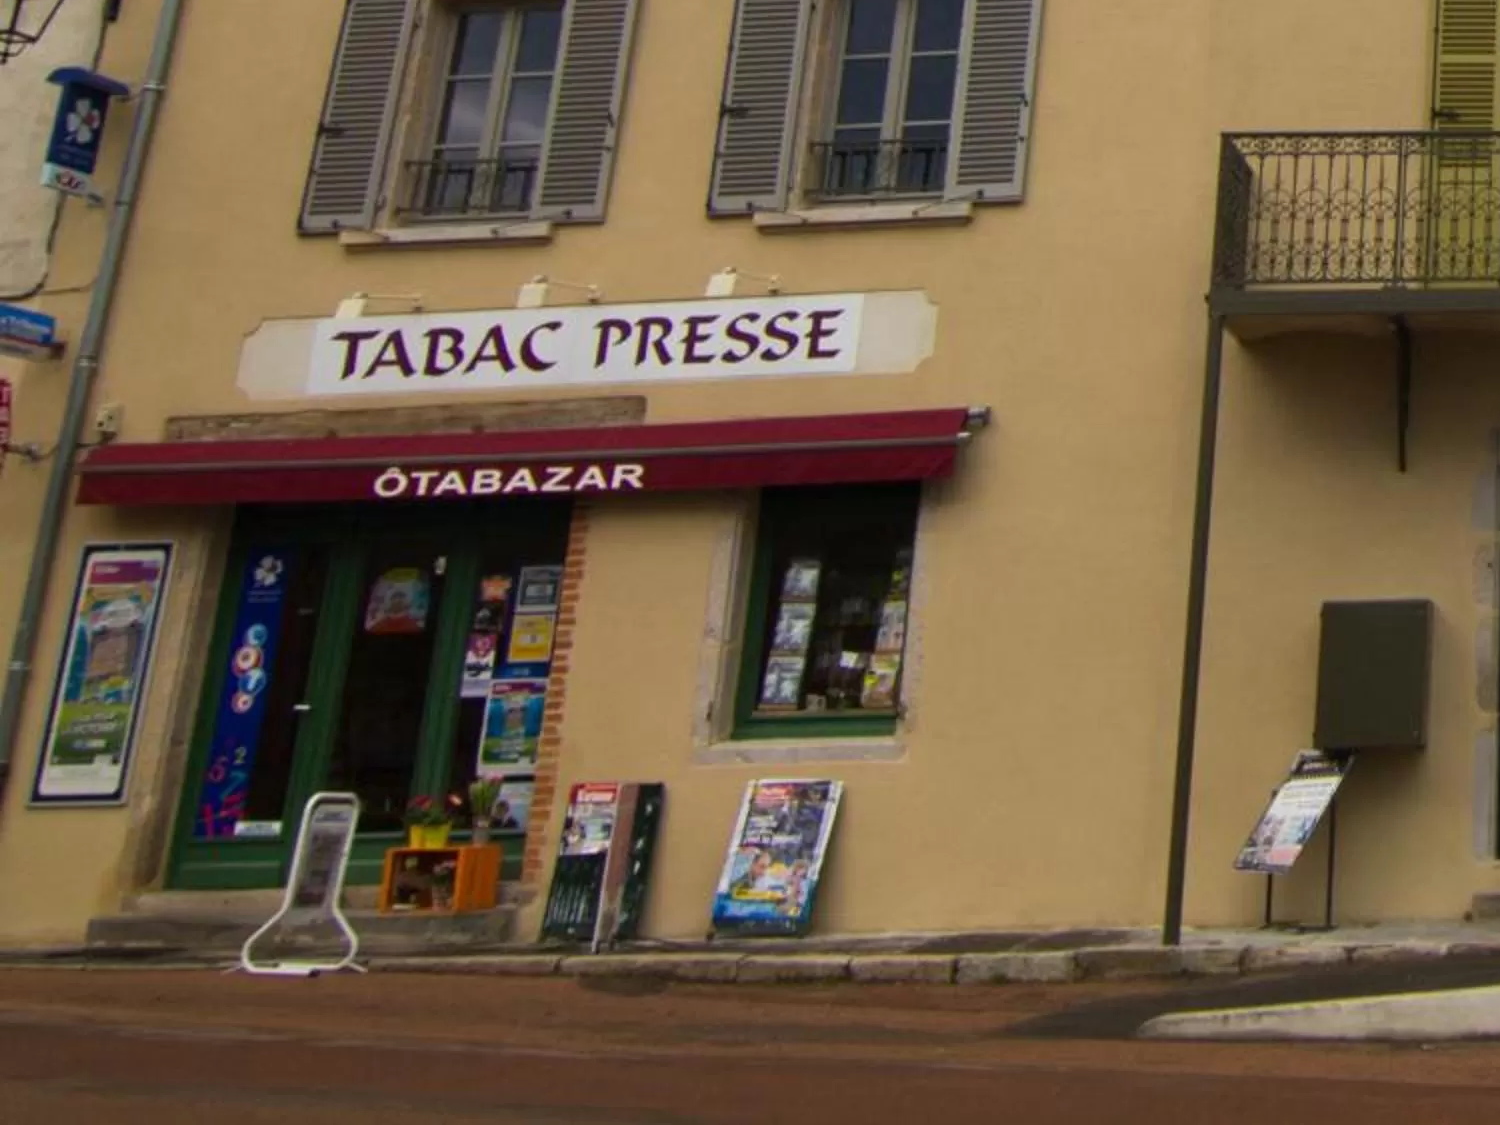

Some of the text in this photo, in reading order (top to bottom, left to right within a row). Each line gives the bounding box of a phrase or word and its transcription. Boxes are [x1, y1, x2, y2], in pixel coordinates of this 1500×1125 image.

[331, 307, 846, 379] TABAC PRESSE
[373, 464, 645, 499] ÔTABAZAR
